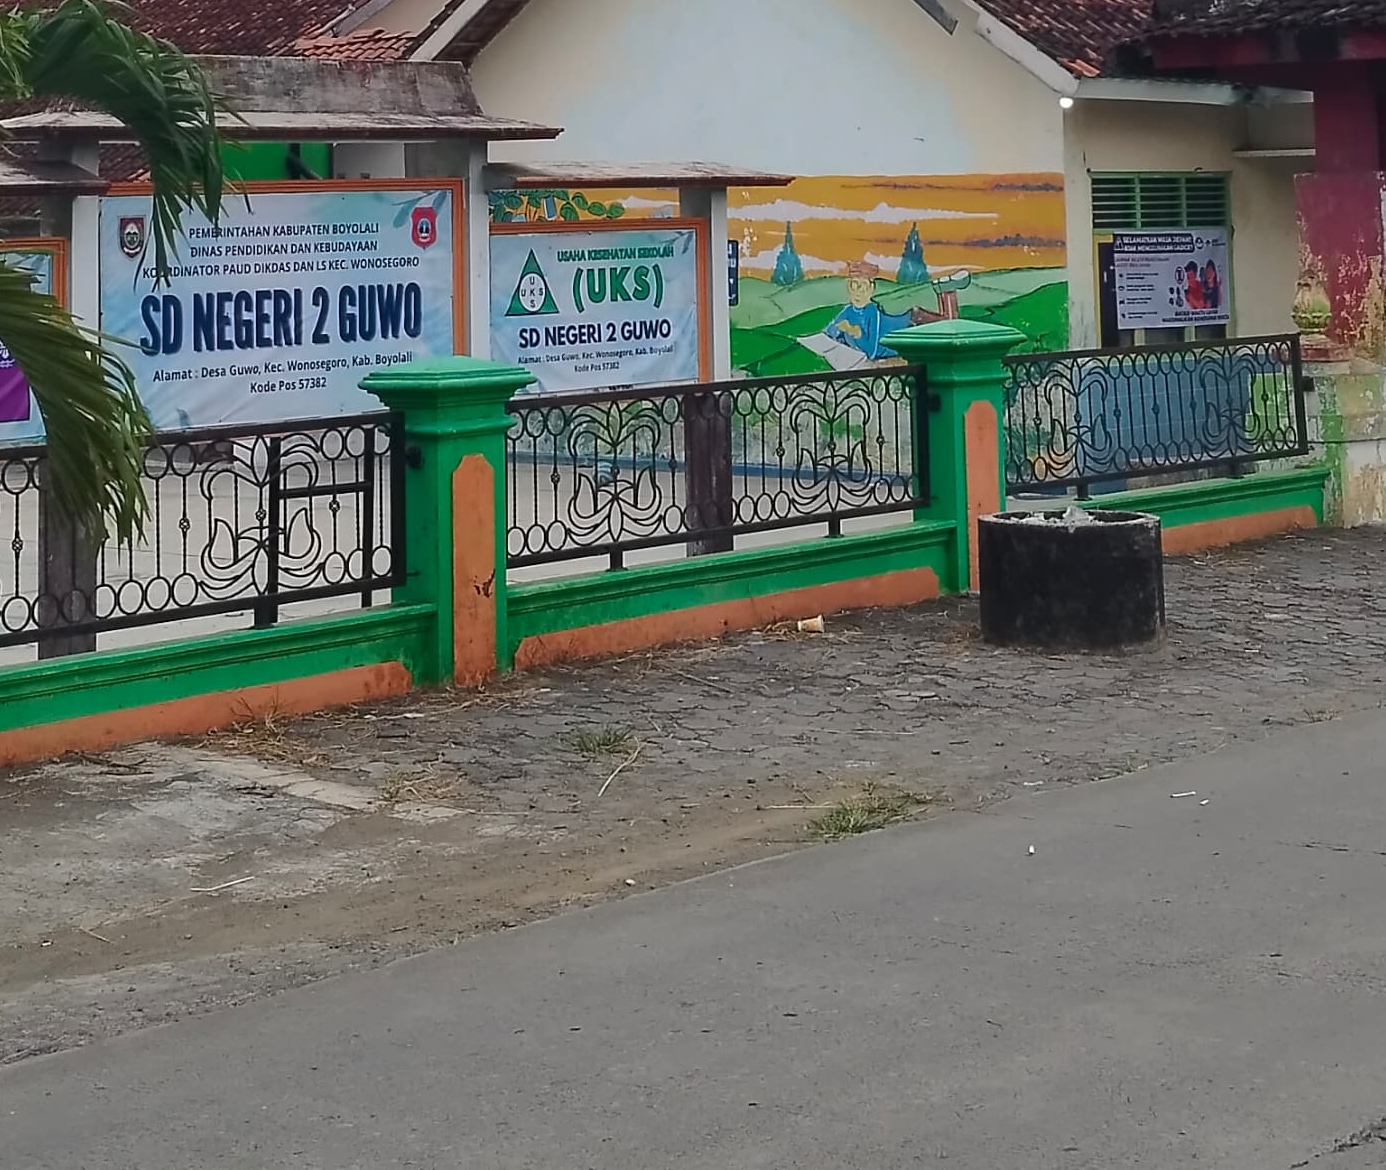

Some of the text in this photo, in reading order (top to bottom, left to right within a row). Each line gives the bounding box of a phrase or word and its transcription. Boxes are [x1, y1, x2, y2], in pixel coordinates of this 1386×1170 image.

[189, 222, 379, 239] PEMERINTAHAN KABUPATEN BOYOLALI
[190, 241, 378, 258] DINAS PENDIDIKAN DAN KEBUDAYAAN
[557, 246, 674, 262] USAHA KESEHATAN SEKOLAH
[142, 256, 420, 279] KORDINATOR PAUD DIKDAS DAN LS KEC. WONOSEGORO
[573, 264, 664, 313] (UKS)
[139, 281, 423, 357] SD NEGERI 2 GUWO
[519, 319, 671, 349] SD NEGERI 2 GUWO
[153, 369, 193, 383] Alamat
[201, 366, 227, 379] Desa
[229, 363, 262, 378] Guwo,
[264, 362, 285, 375] Kec.
[287, 357, 350, 375] Wonosegoro,
[352, 355, 373, 367] Kab.
[375, 351, 413, 366] Boyolali
[518, 356, 542, 364] Alamat
[546, 354, 561, 362] Desa
[574, 363, 590, 373] Kode
[591, 363, 602, 371] Pos
[250, 377, 327, 394] Kode Pos 57382
